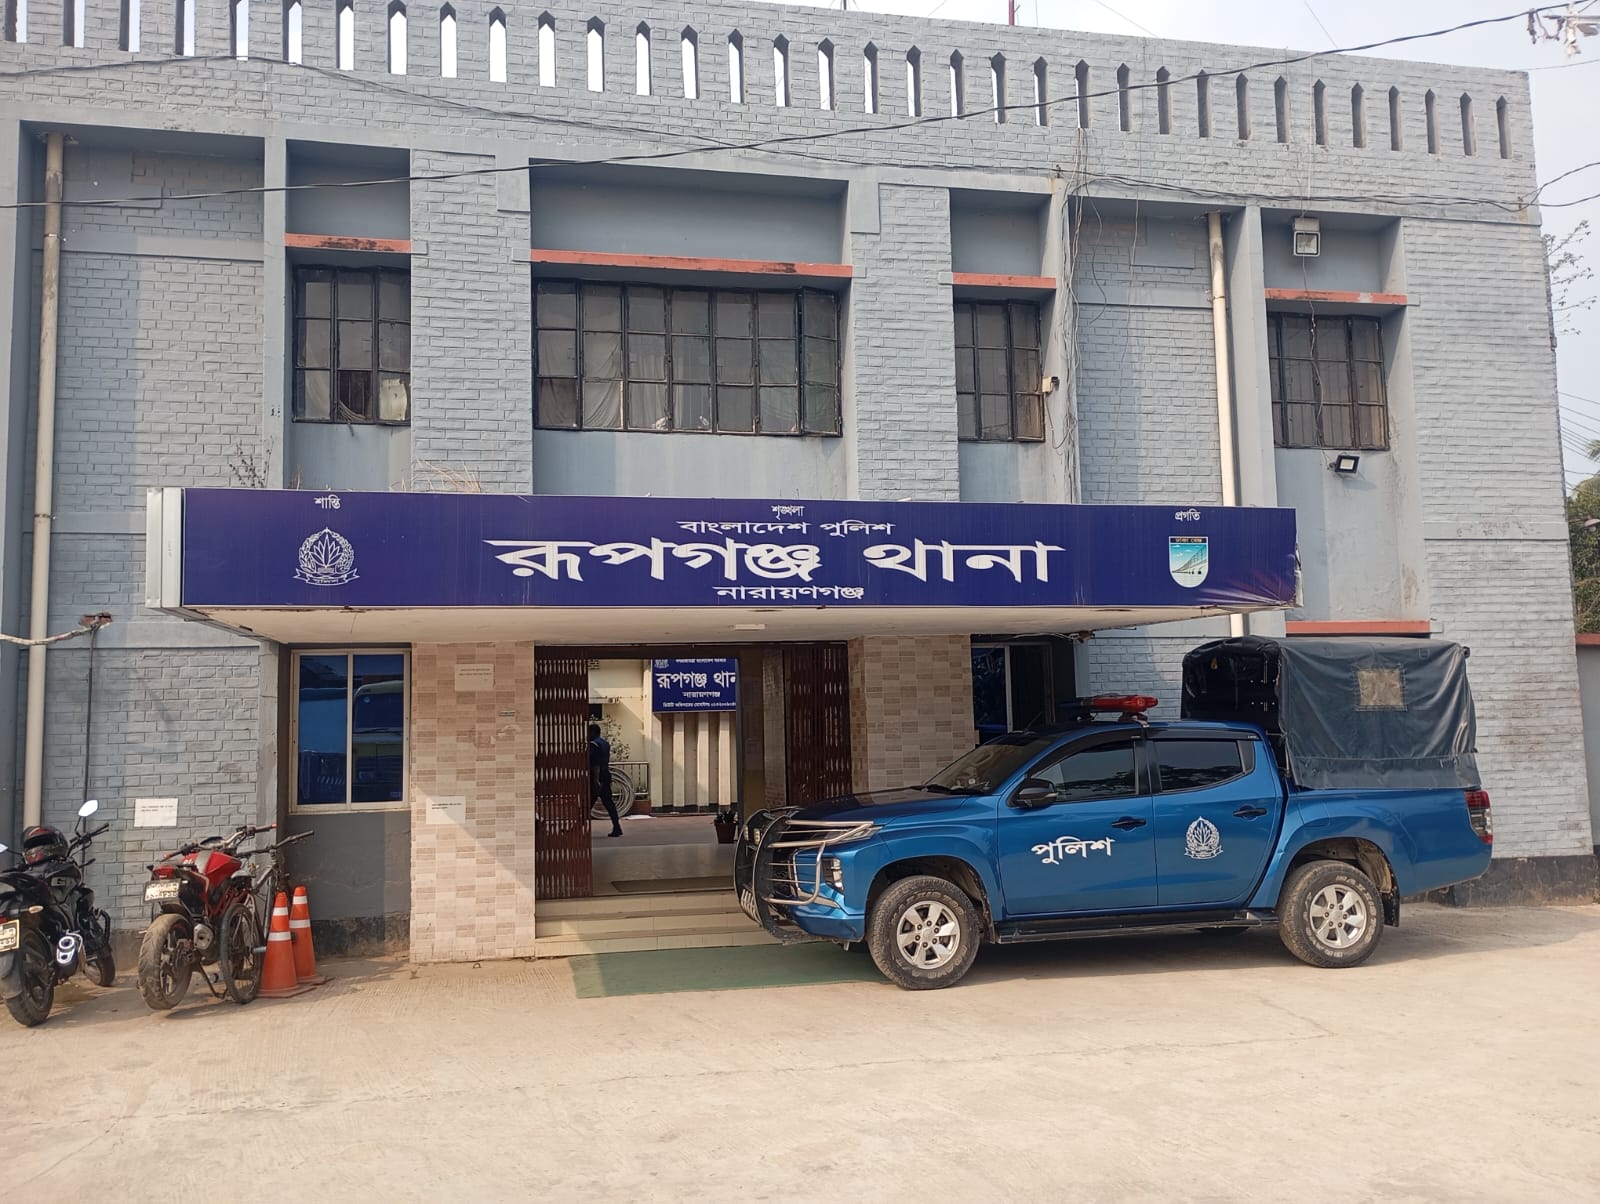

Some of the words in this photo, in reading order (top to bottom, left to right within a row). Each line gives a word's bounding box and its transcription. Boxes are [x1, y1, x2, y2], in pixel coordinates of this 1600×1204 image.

[314, 494, 341, 509] শান্তি
[1175, 509, 1200, 521] প্রগতি
[677, 521, 811, 534] বাংলাদেশ
[820, 519, 896, 537] পুলিশ
[483, 537, 822, 582] রূপগঞ্জ
[863, 538, 1066, 583] থানা
[712, 585, 864, 599] নারায়ণগঞ্জ
[656, 672, 707, 689] রূপগঞ্জ
[1031, 836, 1115, 864] পুলিশ
